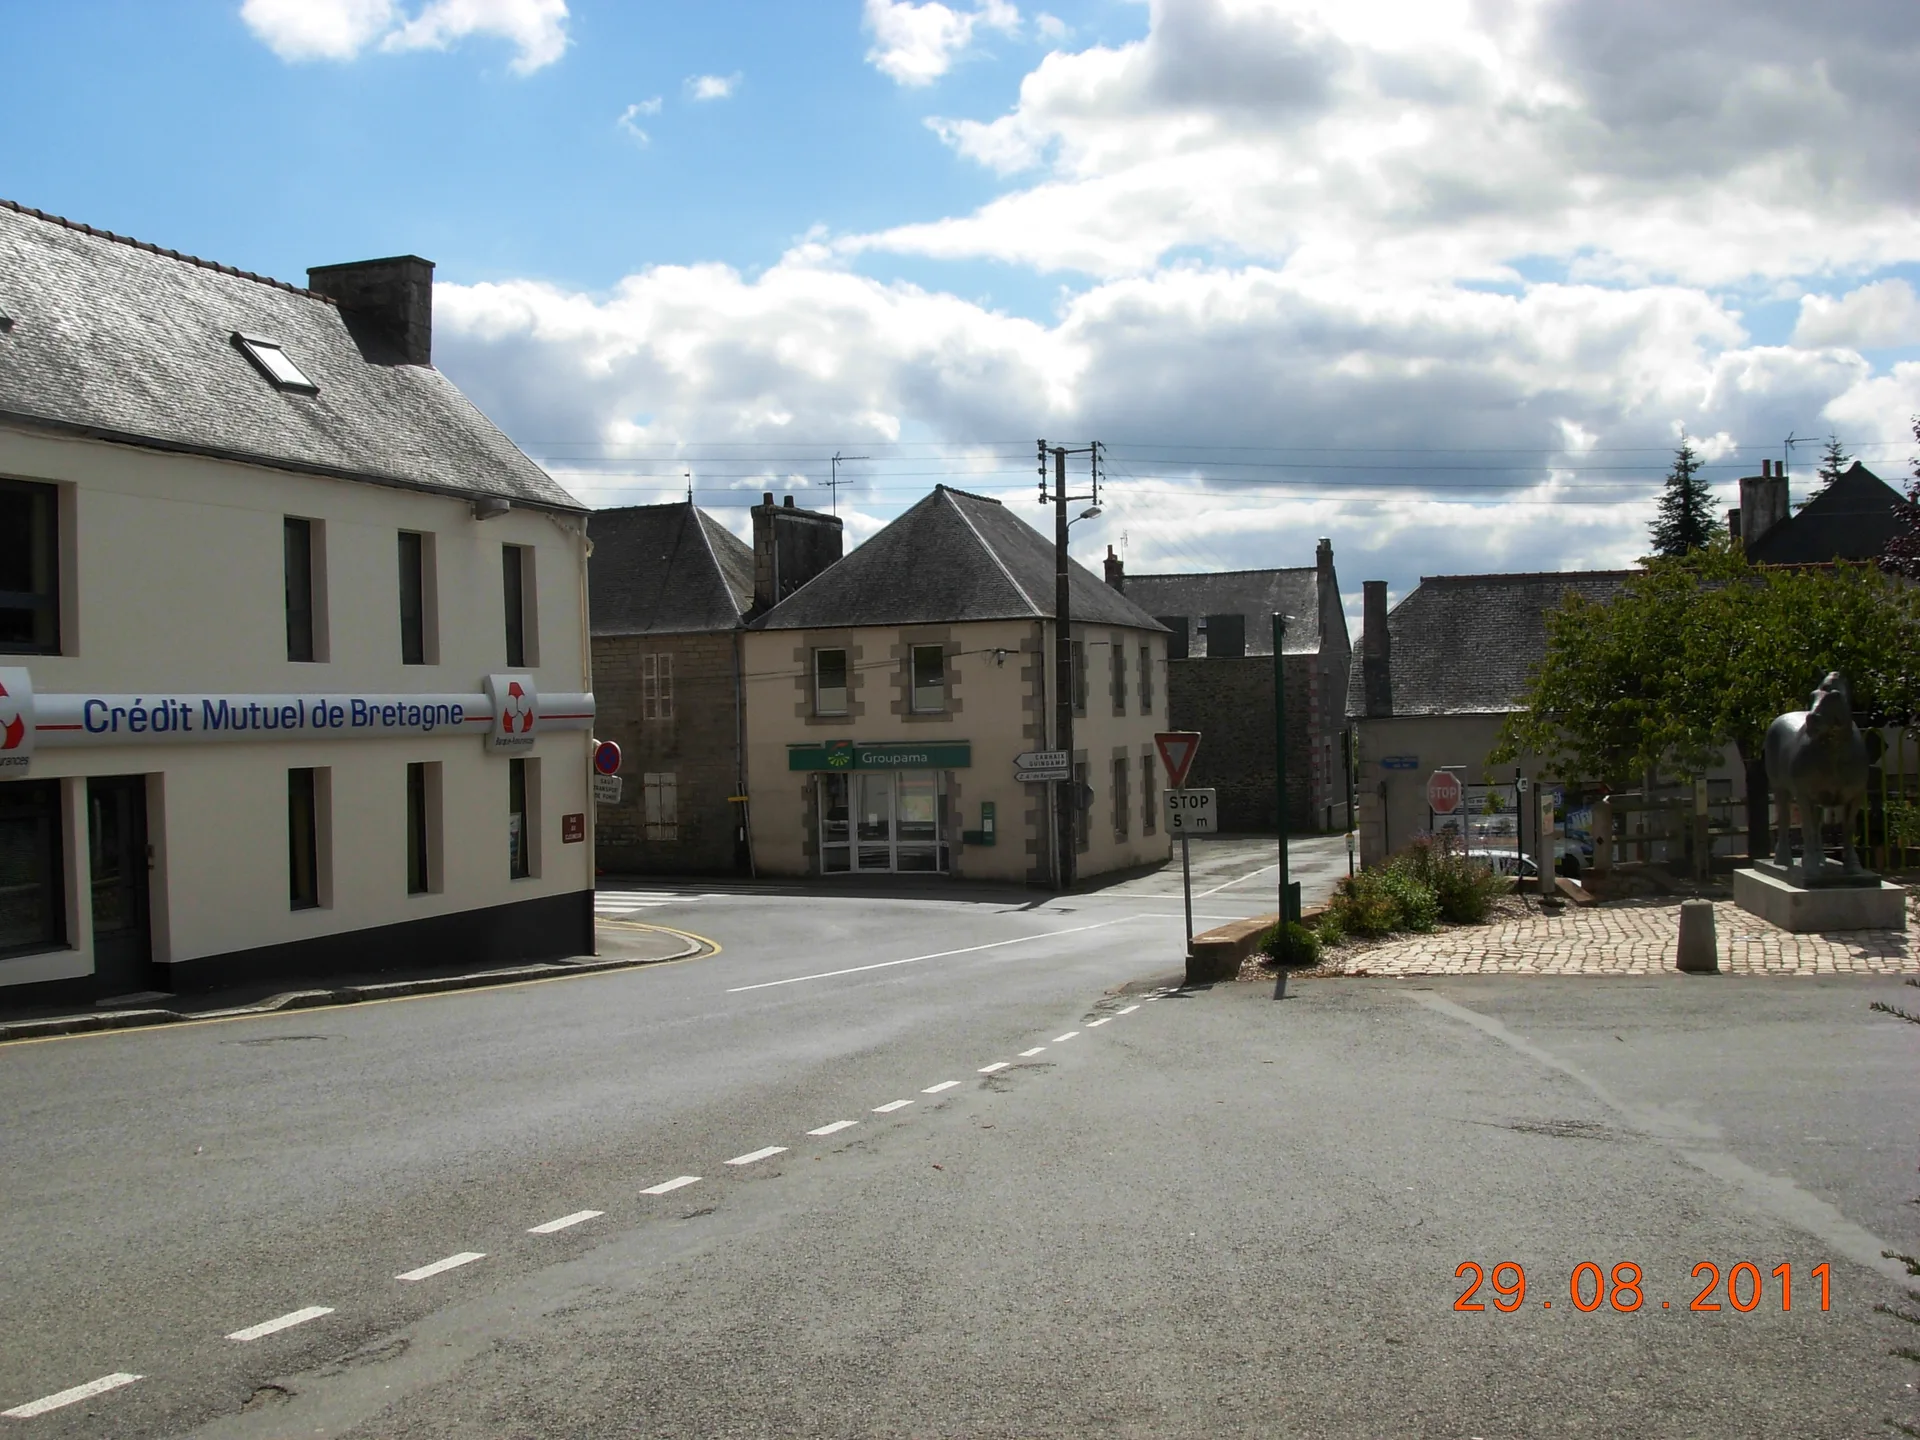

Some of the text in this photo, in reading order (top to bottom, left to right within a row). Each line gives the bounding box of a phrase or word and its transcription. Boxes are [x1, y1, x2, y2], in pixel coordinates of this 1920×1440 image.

[83, 698, 464, 734] Crédit Mutuel de Bretagne
[862, 752, 928, 767] Groupama
[1430, 786, 1457, 799] STOP
[1169, 795, 1209, 809] STOP
[1173, 814, 1208, 827] 5 m
